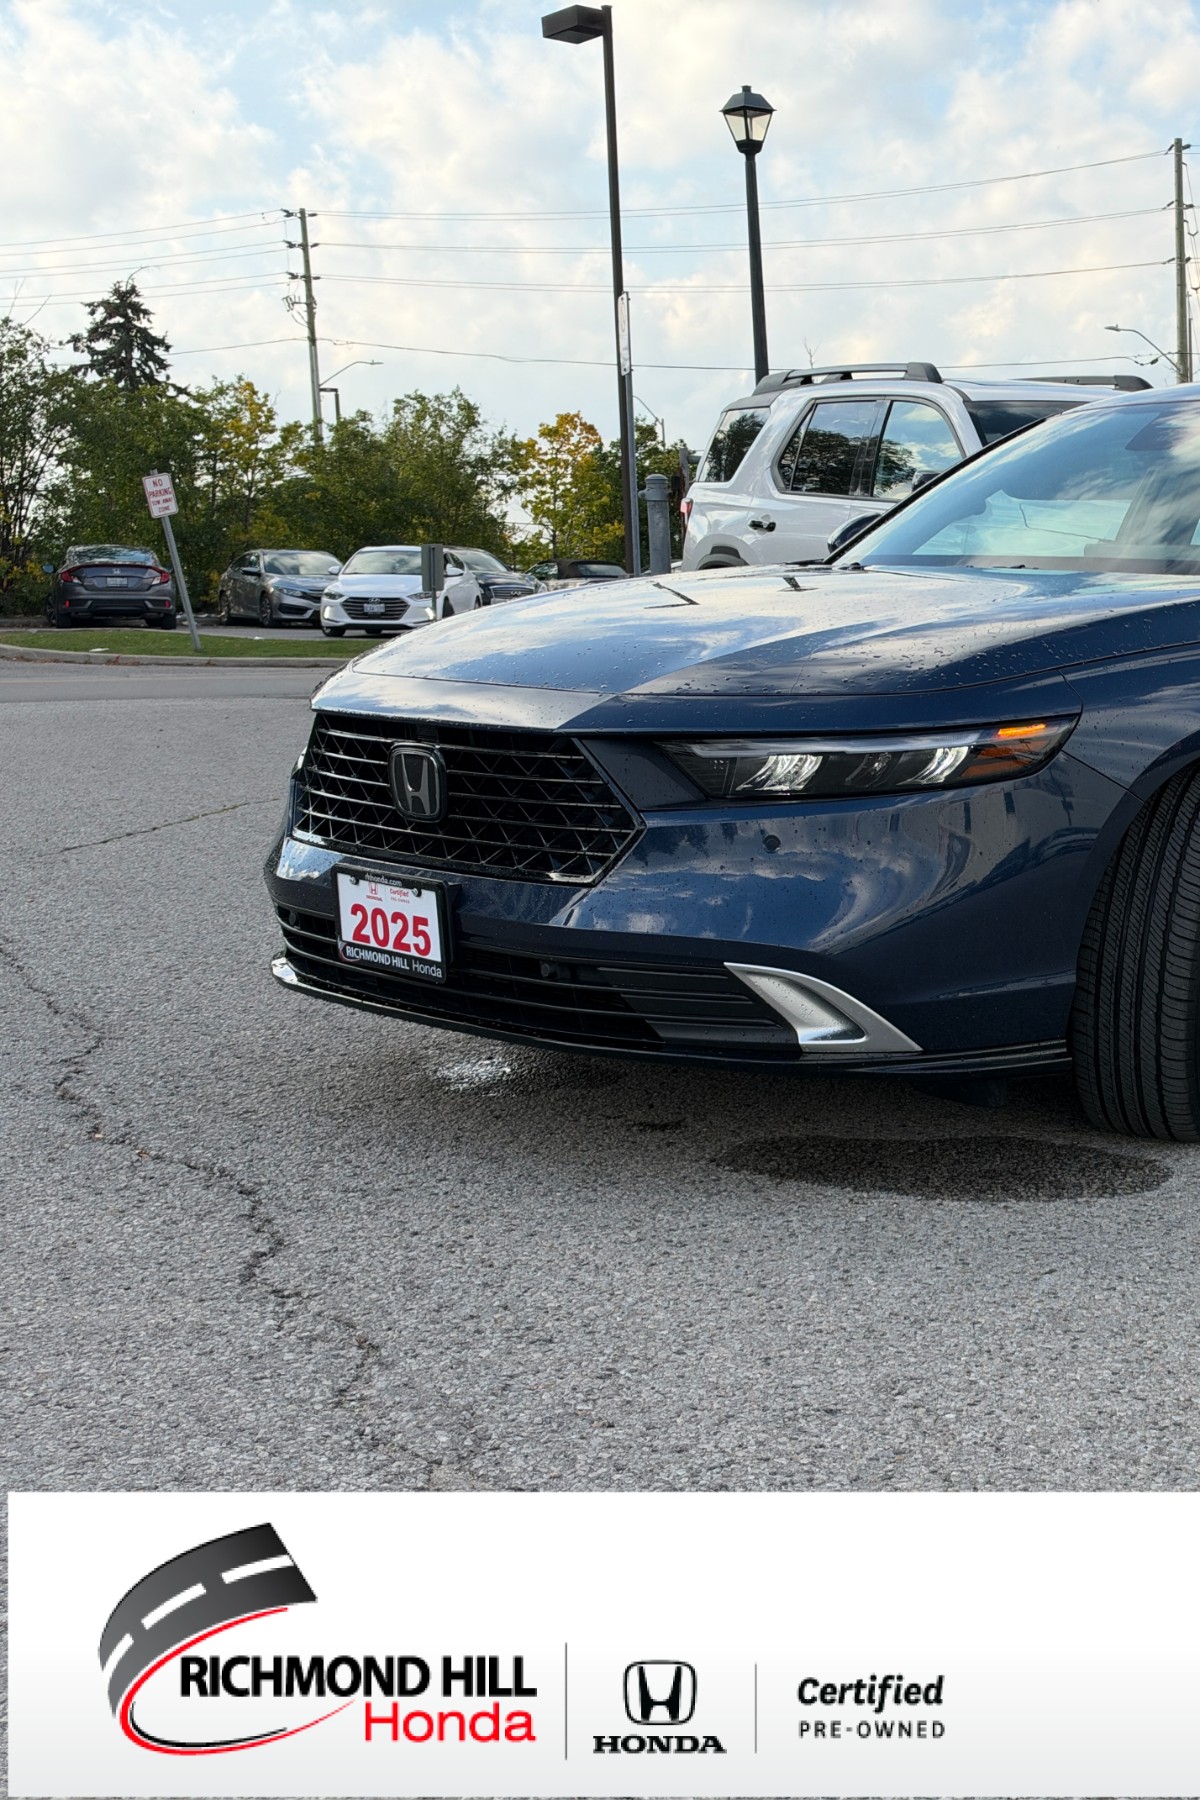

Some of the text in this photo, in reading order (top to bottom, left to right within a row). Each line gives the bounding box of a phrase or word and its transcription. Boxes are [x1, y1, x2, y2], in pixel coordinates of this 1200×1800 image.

[148, 487, 172, 498] PARKING
[152, 479, 163, 487] NO
[350, 903, 431, 957] 2025
[345, 945, 442, 978] RICHMOND HILL Honda
